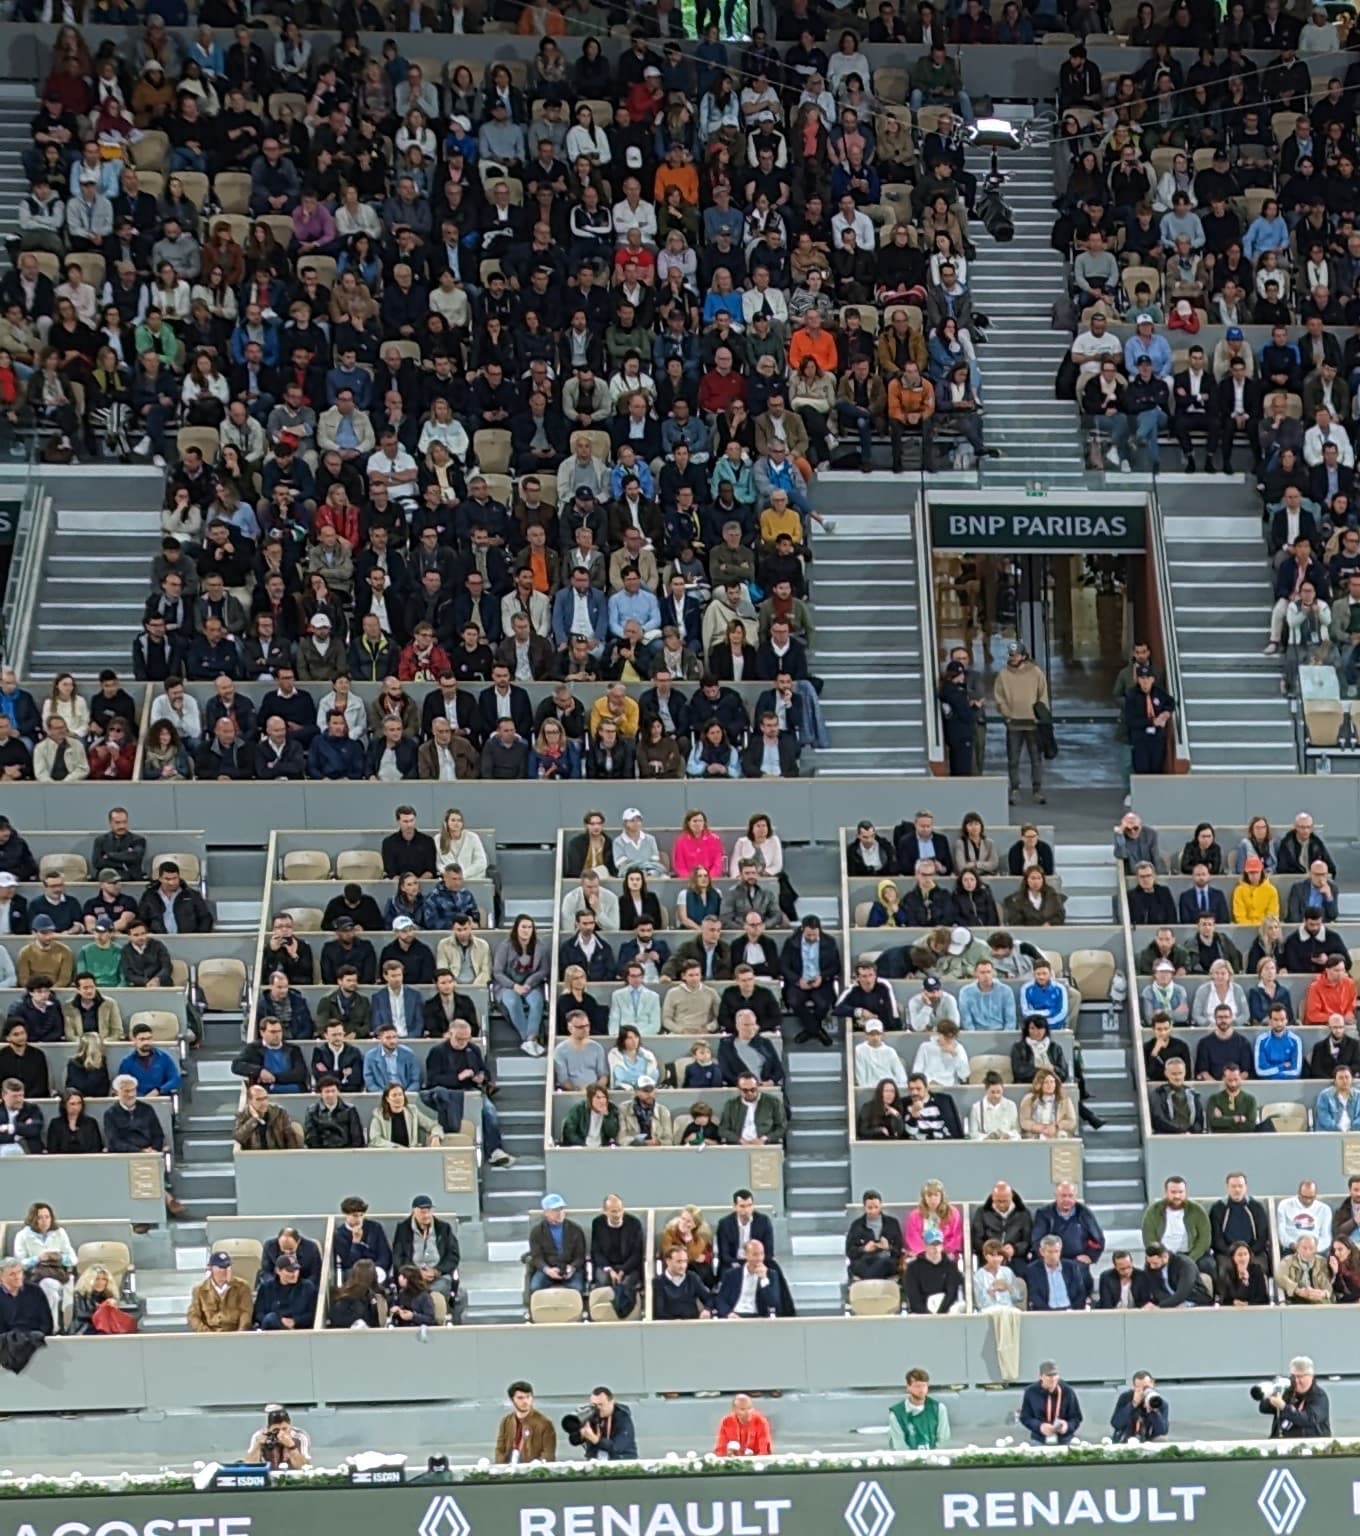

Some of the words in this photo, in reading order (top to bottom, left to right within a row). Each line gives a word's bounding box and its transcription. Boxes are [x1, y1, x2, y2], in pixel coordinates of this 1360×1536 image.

[949, 515, 1006, 536] BNP
[1012, 516, 1127, 536] PARIBAS
[942, 1485, 1207, 1529] RENAULT
